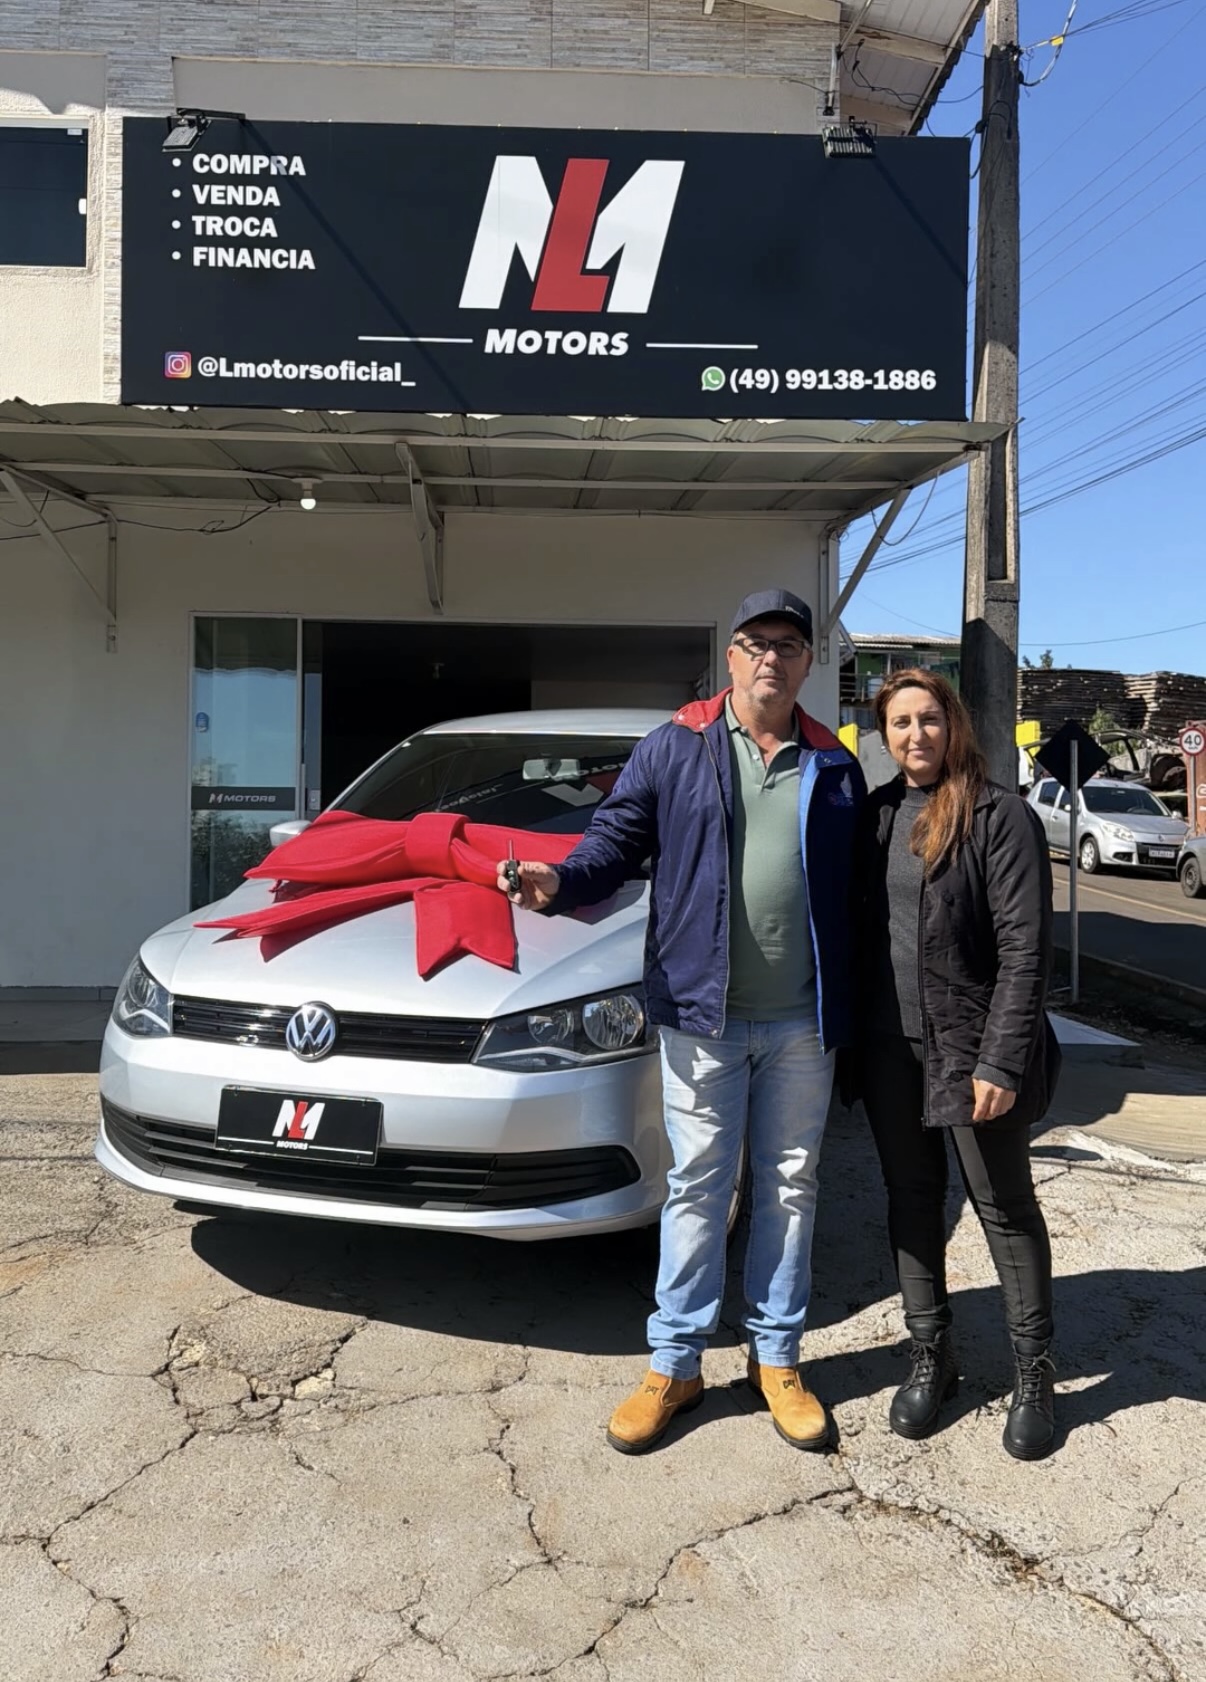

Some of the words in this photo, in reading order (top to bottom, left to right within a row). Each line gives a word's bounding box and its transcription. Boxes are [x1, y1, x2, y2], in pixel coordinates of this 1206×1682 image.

[192, 153, 306, 176] COMPRA
[192, 184, 281, 207] VENDA
[192, 215, 278, 238] TROCA
[192, 247, 316, 270] FINANCIA
[484, 328, 629, 356] MOTORS
[198, 357, 416, 387] @Lmotorsoficial_
[729, 368, 780, 395] (49)
[785, 369, 937, 391] 99138-1886
[1184, 734, 1202, 746] 40
[223, 794, 276, 803] MOTORS
[276, 1140, 308, 1150] MOTORS
